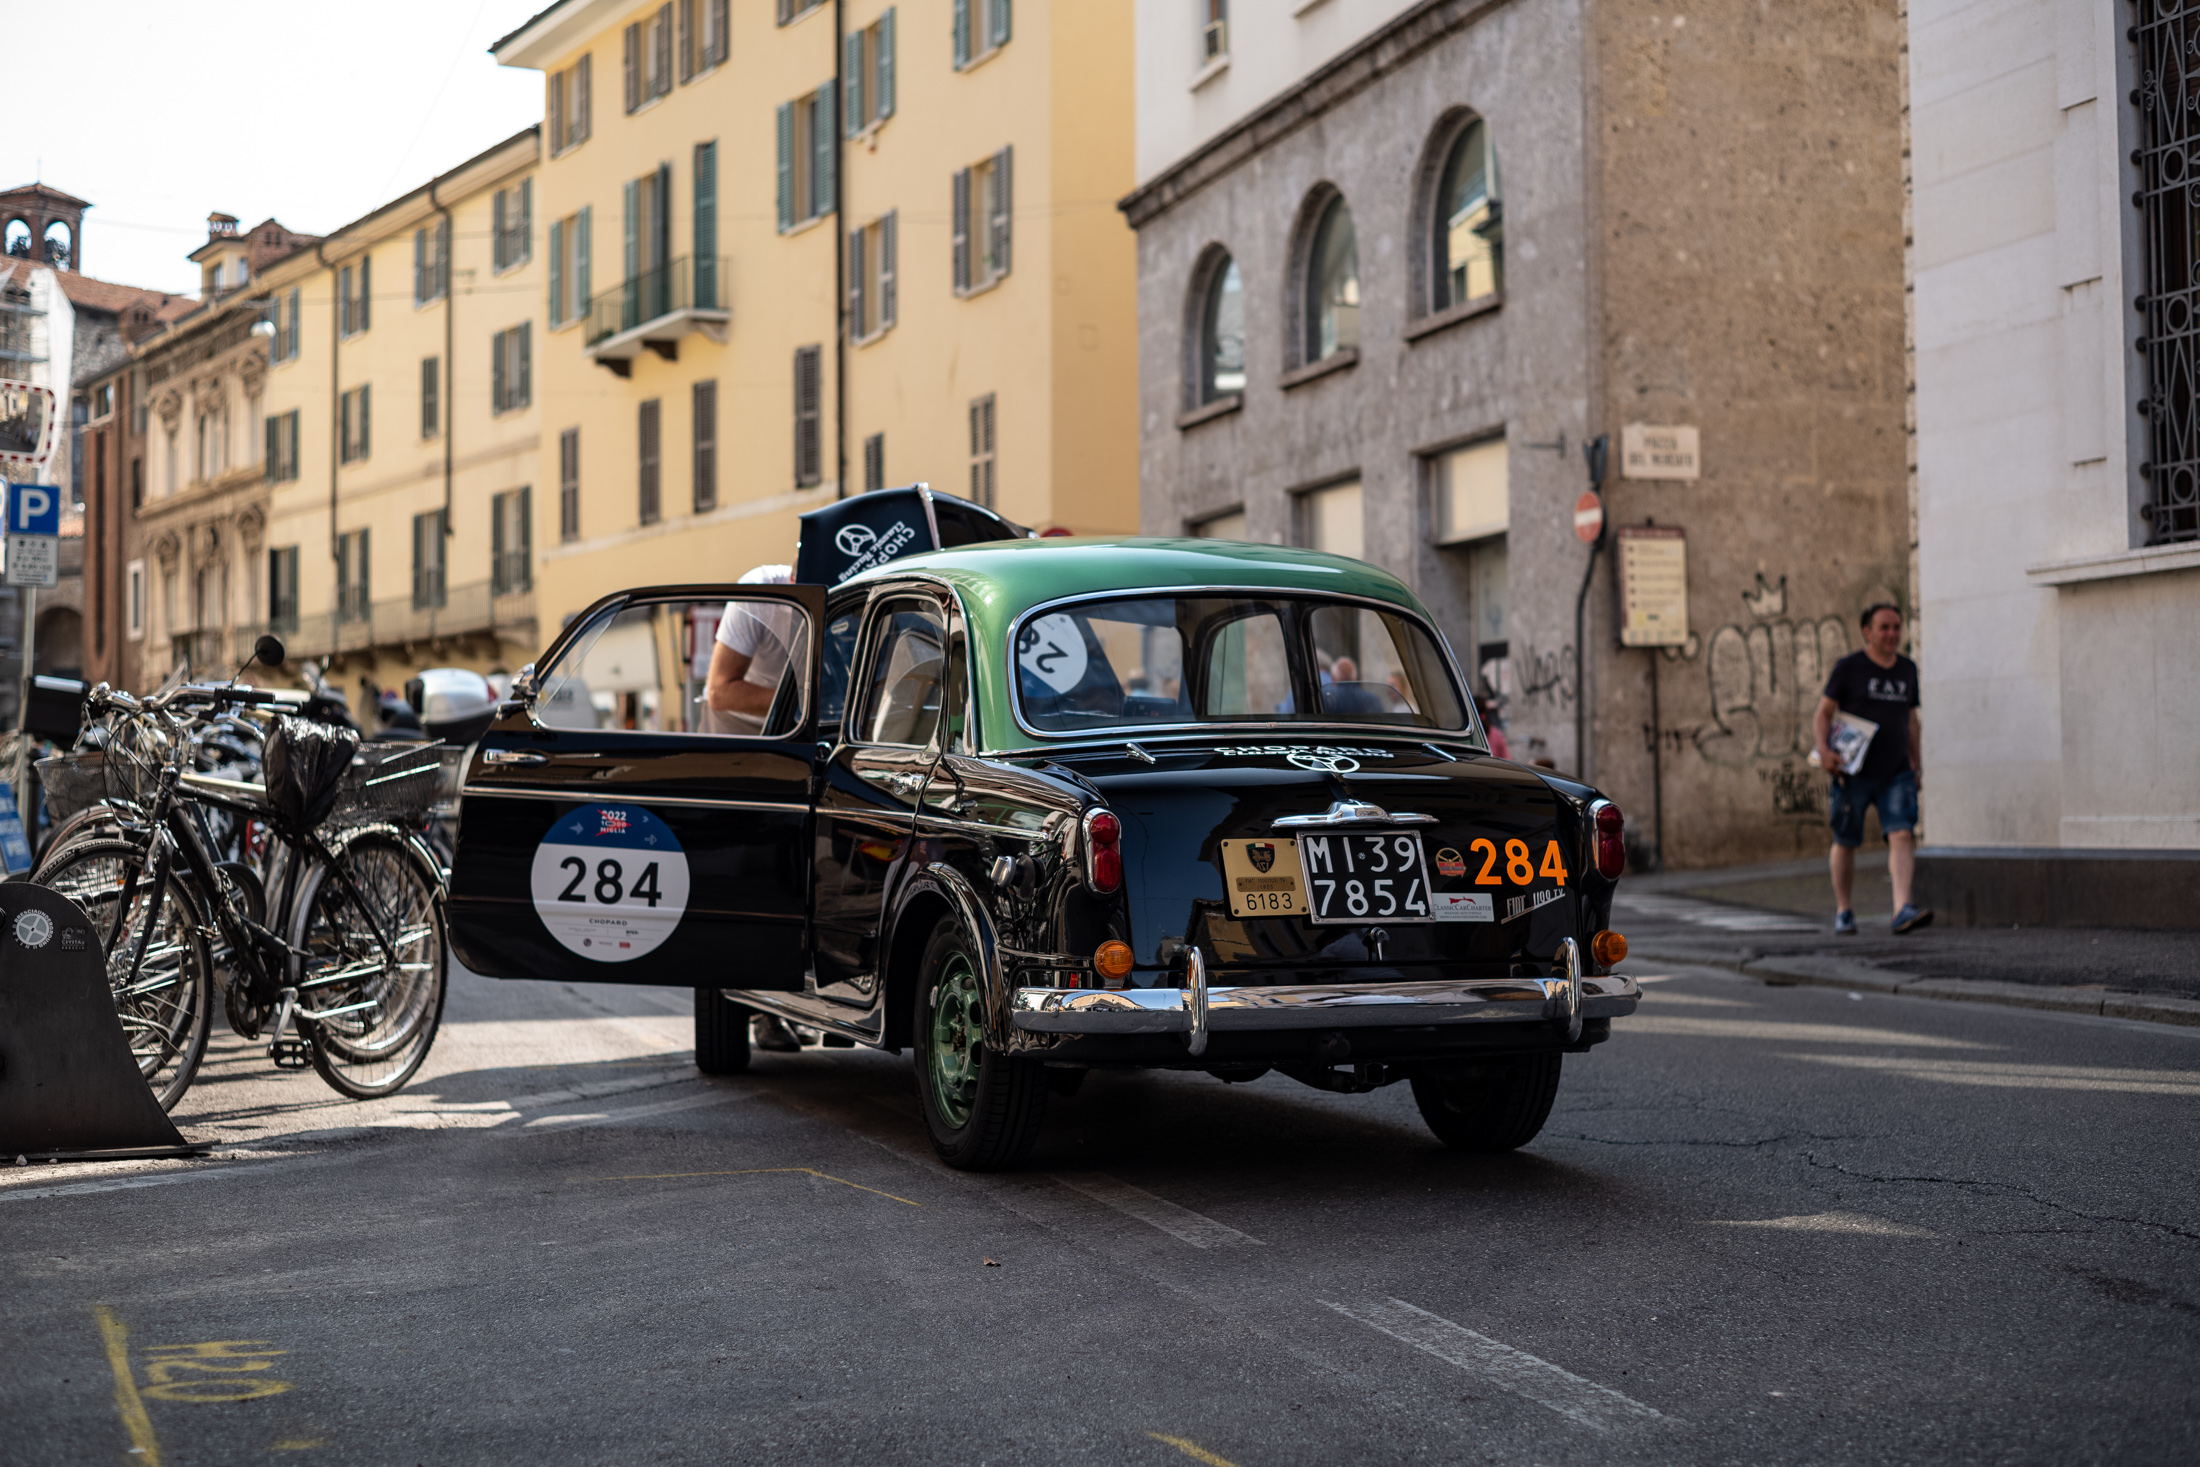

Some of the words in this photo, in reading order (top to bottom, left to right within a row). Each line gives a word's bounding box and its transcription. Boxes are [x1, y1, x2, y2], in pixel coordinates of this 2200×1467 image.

[18, 488, 51, 530] P
[861, 527, 916, 572] CHOPA
[869, 520, 906, 553] Classic
[838, 551, 875, 582] Racing
[1213, 745, 1387, 753] CHOPARD
[600, 826, 626, 834] MIGLIA
[601, 809, 627, 821] 2022
[1470, 838, 1568, 886] 284
[557, 856, 663, 908] 284
[1313, 879, 1426, 916] 7854
[1246, 893, 1293, 911] 6183
[1506, 894, 1526, 918] FIAT
[1532, 889, 1551, 909] 1100
[589, 918, 628, 926] CHOPARD
